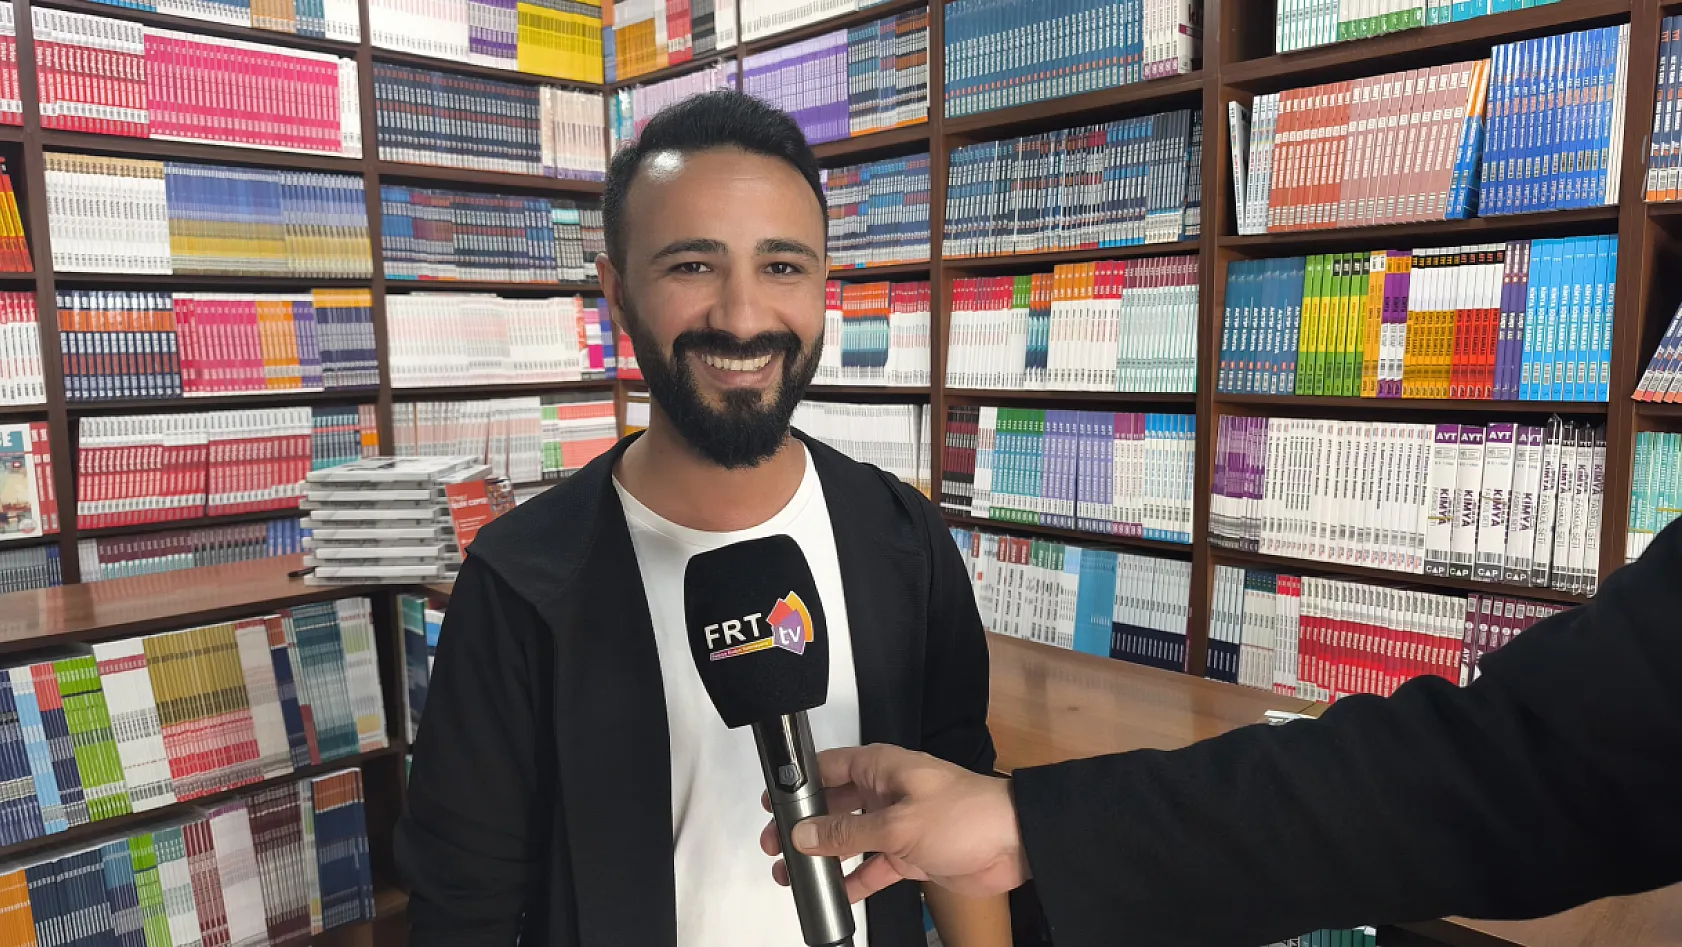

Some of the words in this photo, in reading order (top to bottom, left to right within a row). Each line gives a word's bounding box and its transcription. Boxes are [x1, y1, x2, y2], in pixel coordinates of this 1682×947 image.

[1436, 432, 1458, 441] AYT
[1461, 432, 1483, 442] AYT
[1488, 431, 1512, 440] AYT
[1519, 434, 1542, 443] AYT
[704, 612, 762, 649] FRT
[779, 626, 800, 644] tv
